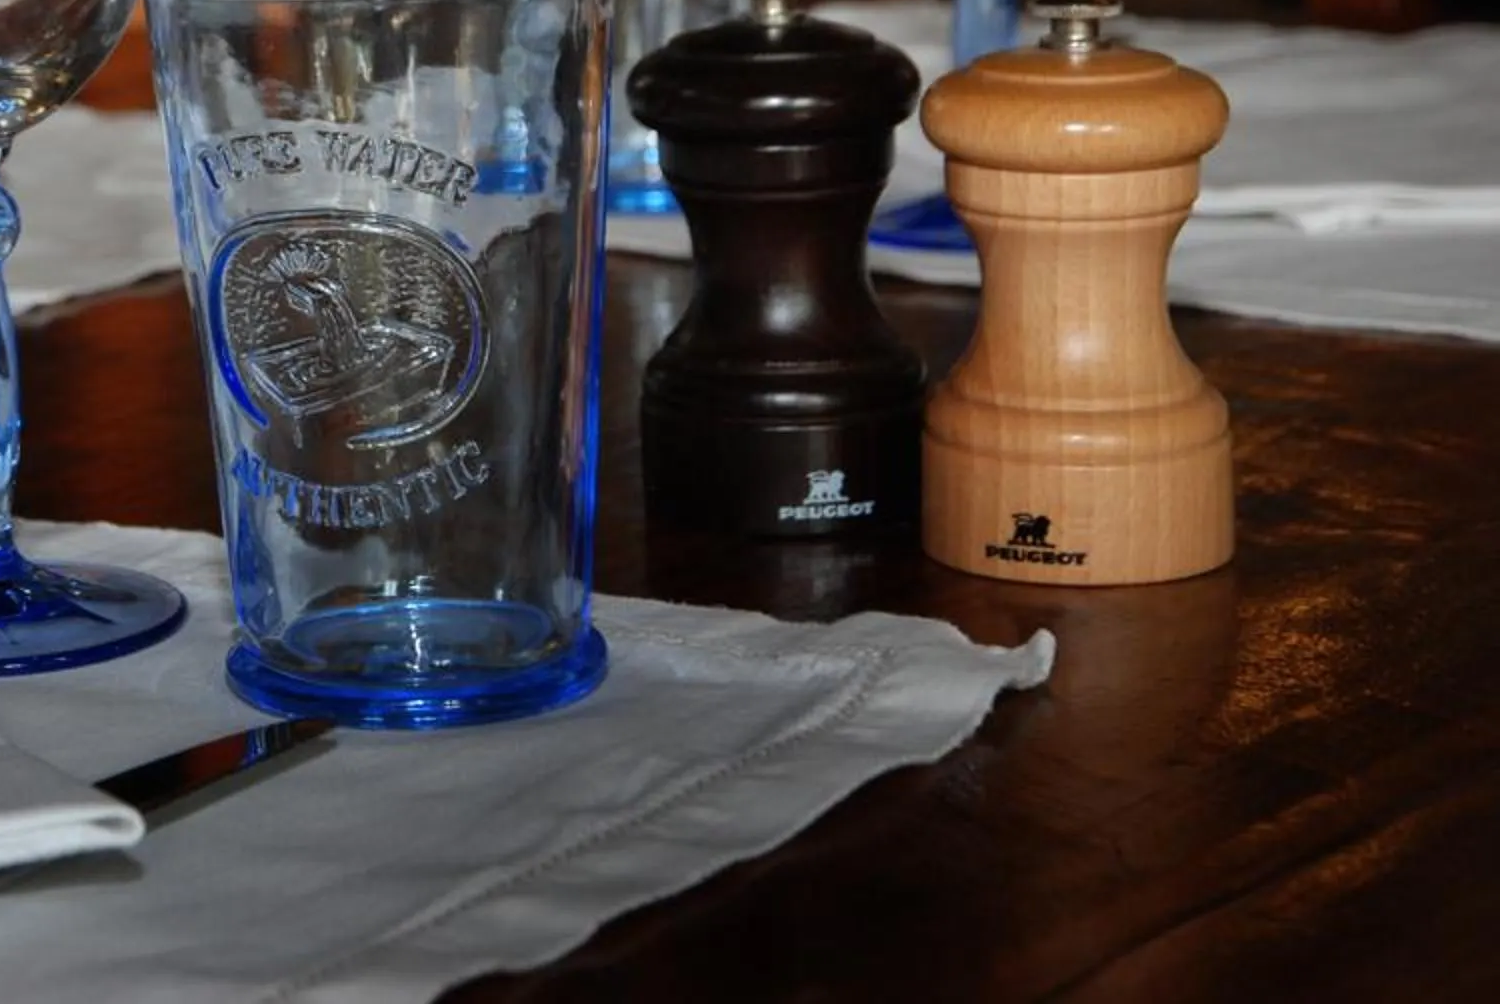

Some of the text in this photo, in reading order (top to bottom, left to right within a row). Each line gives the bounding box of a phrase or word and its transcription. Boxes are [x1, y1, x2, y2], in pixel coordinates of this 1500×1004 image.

[315, 129, 477, 206] WATER
[778, 499, 876, 520] PEUGEOT
[984, 544, 1088, 567] PEUGEOT
